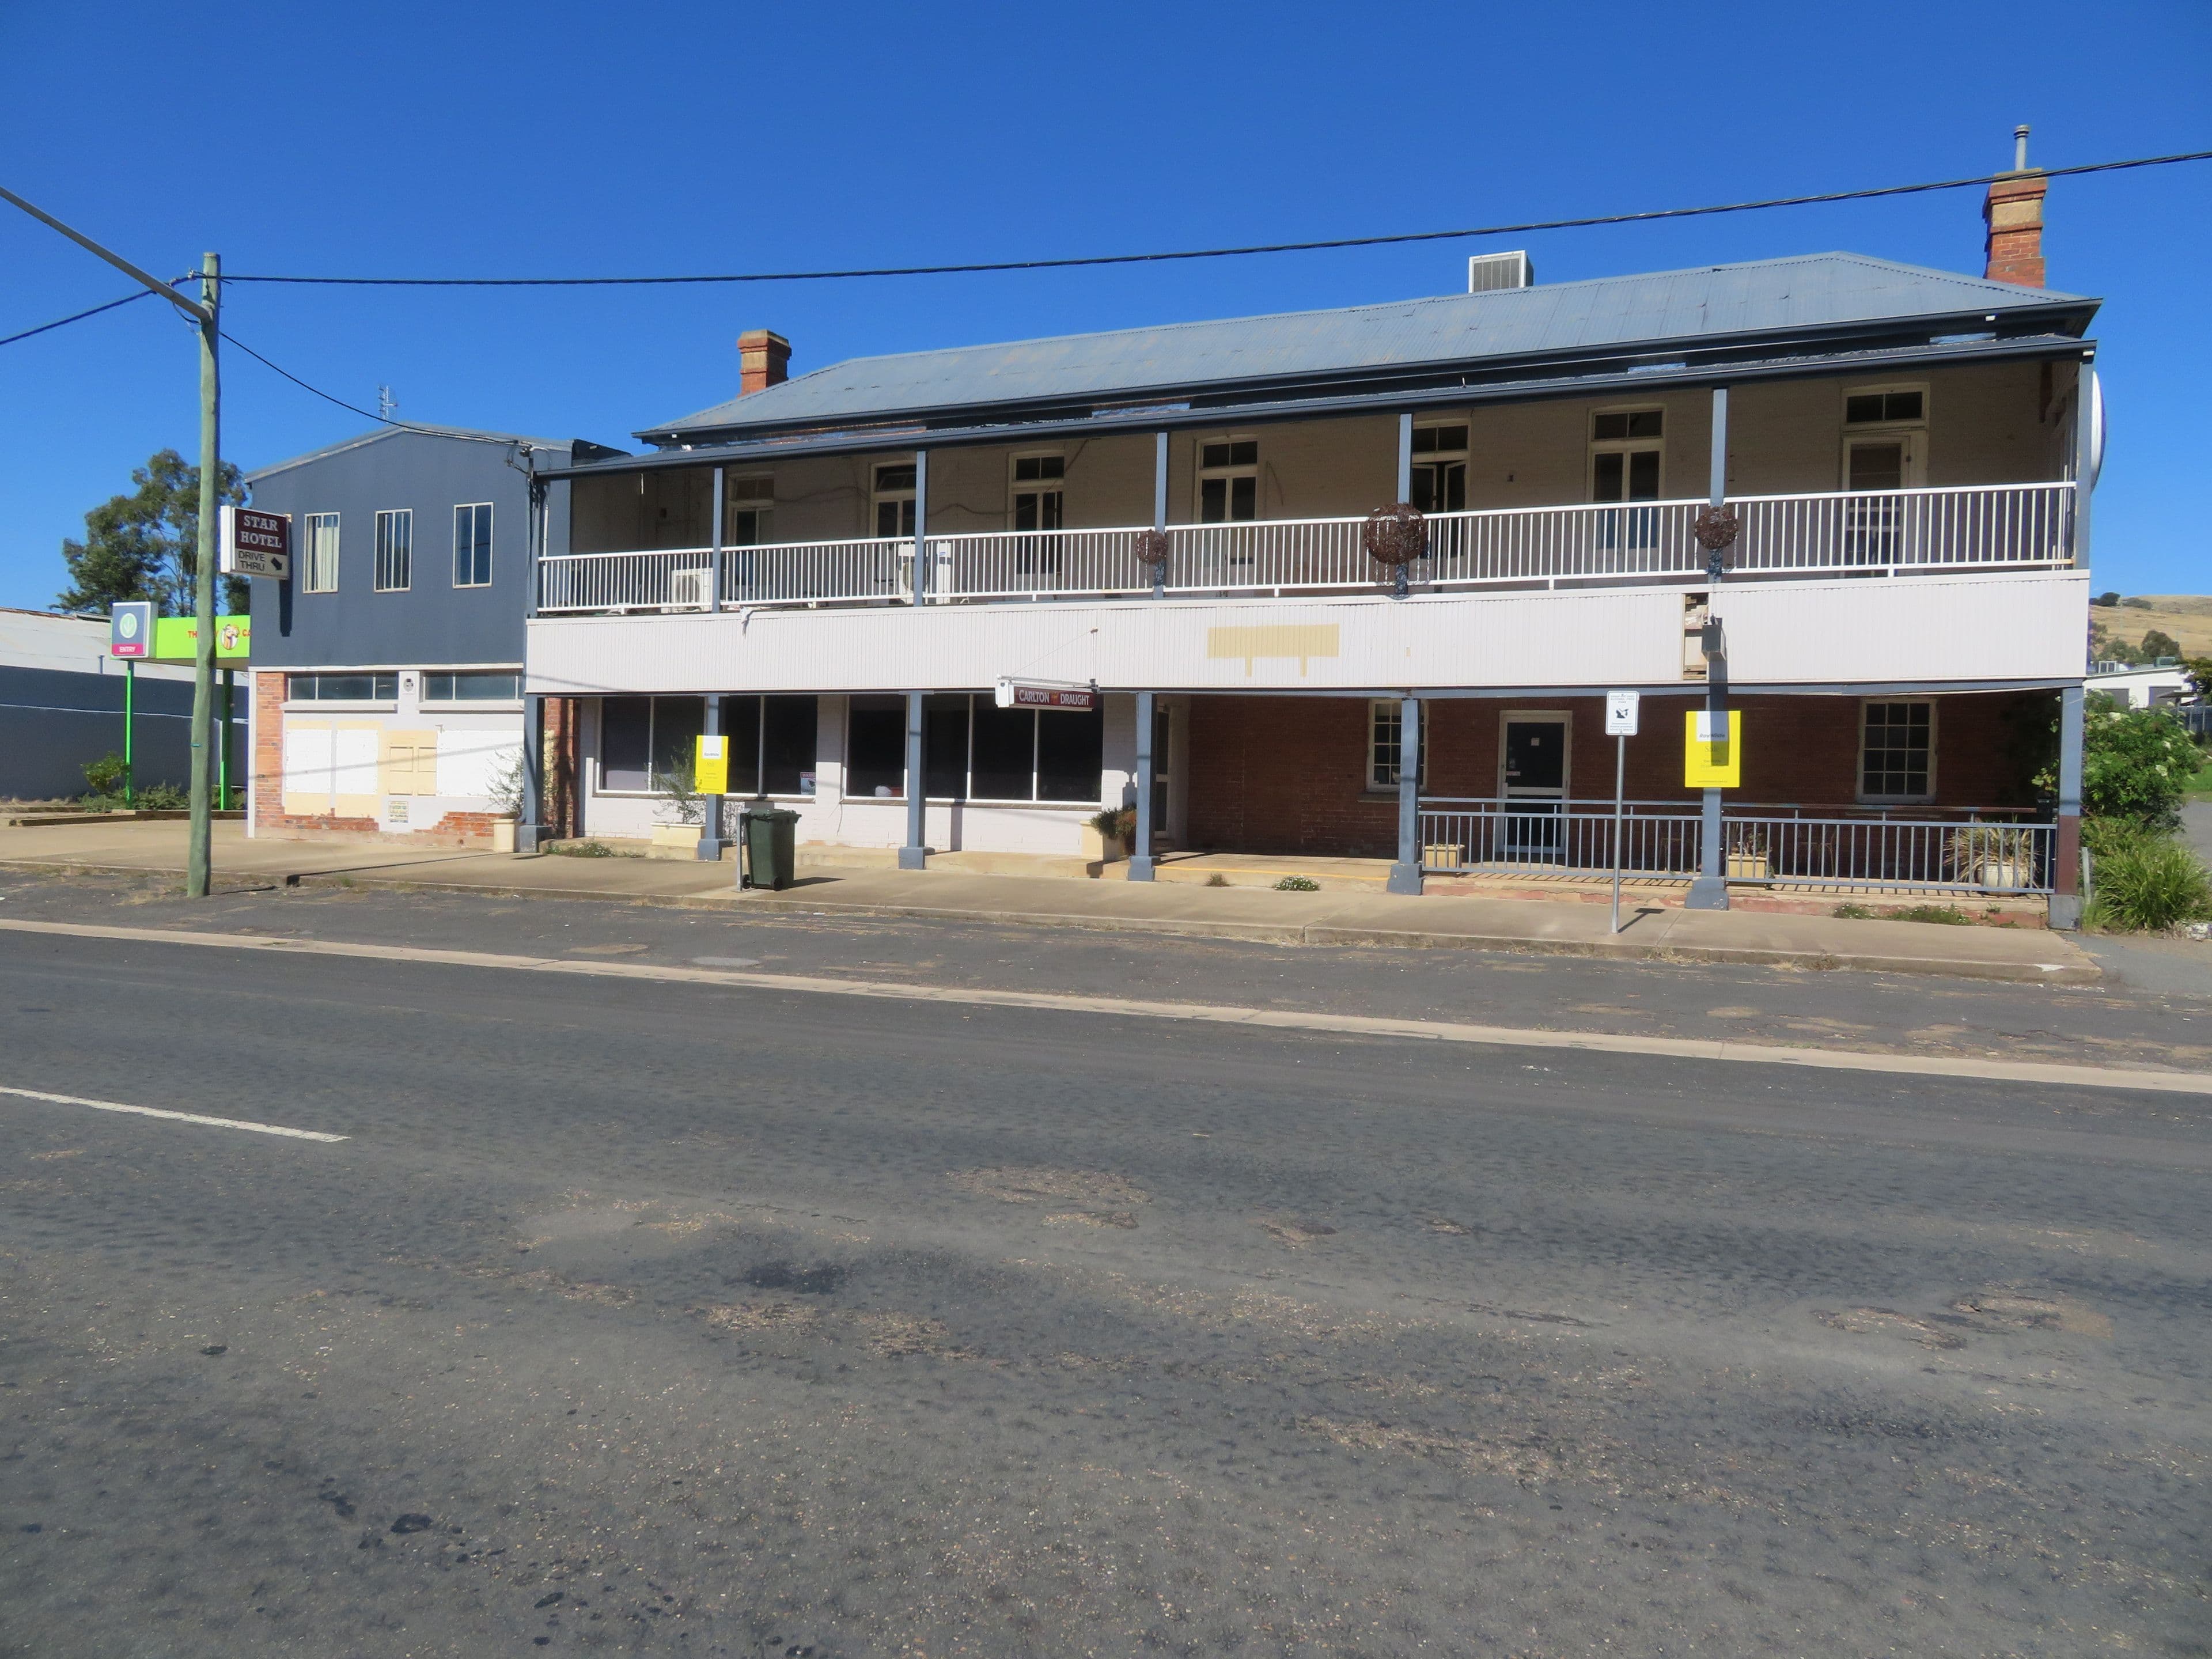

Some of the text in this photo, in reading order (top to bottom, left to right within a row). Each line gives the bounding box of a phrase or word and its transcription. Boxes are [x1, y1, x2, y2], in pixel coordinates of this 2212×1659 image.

[244, 515, 278, 531] STAR
[240, 531, 282, 548] HOTEL
[238, 551, 266, 562] DRIVE
[240, 560, 265, 571] THRU
[1019, 690, 1090, 706] CARLTON DRAUGHT
